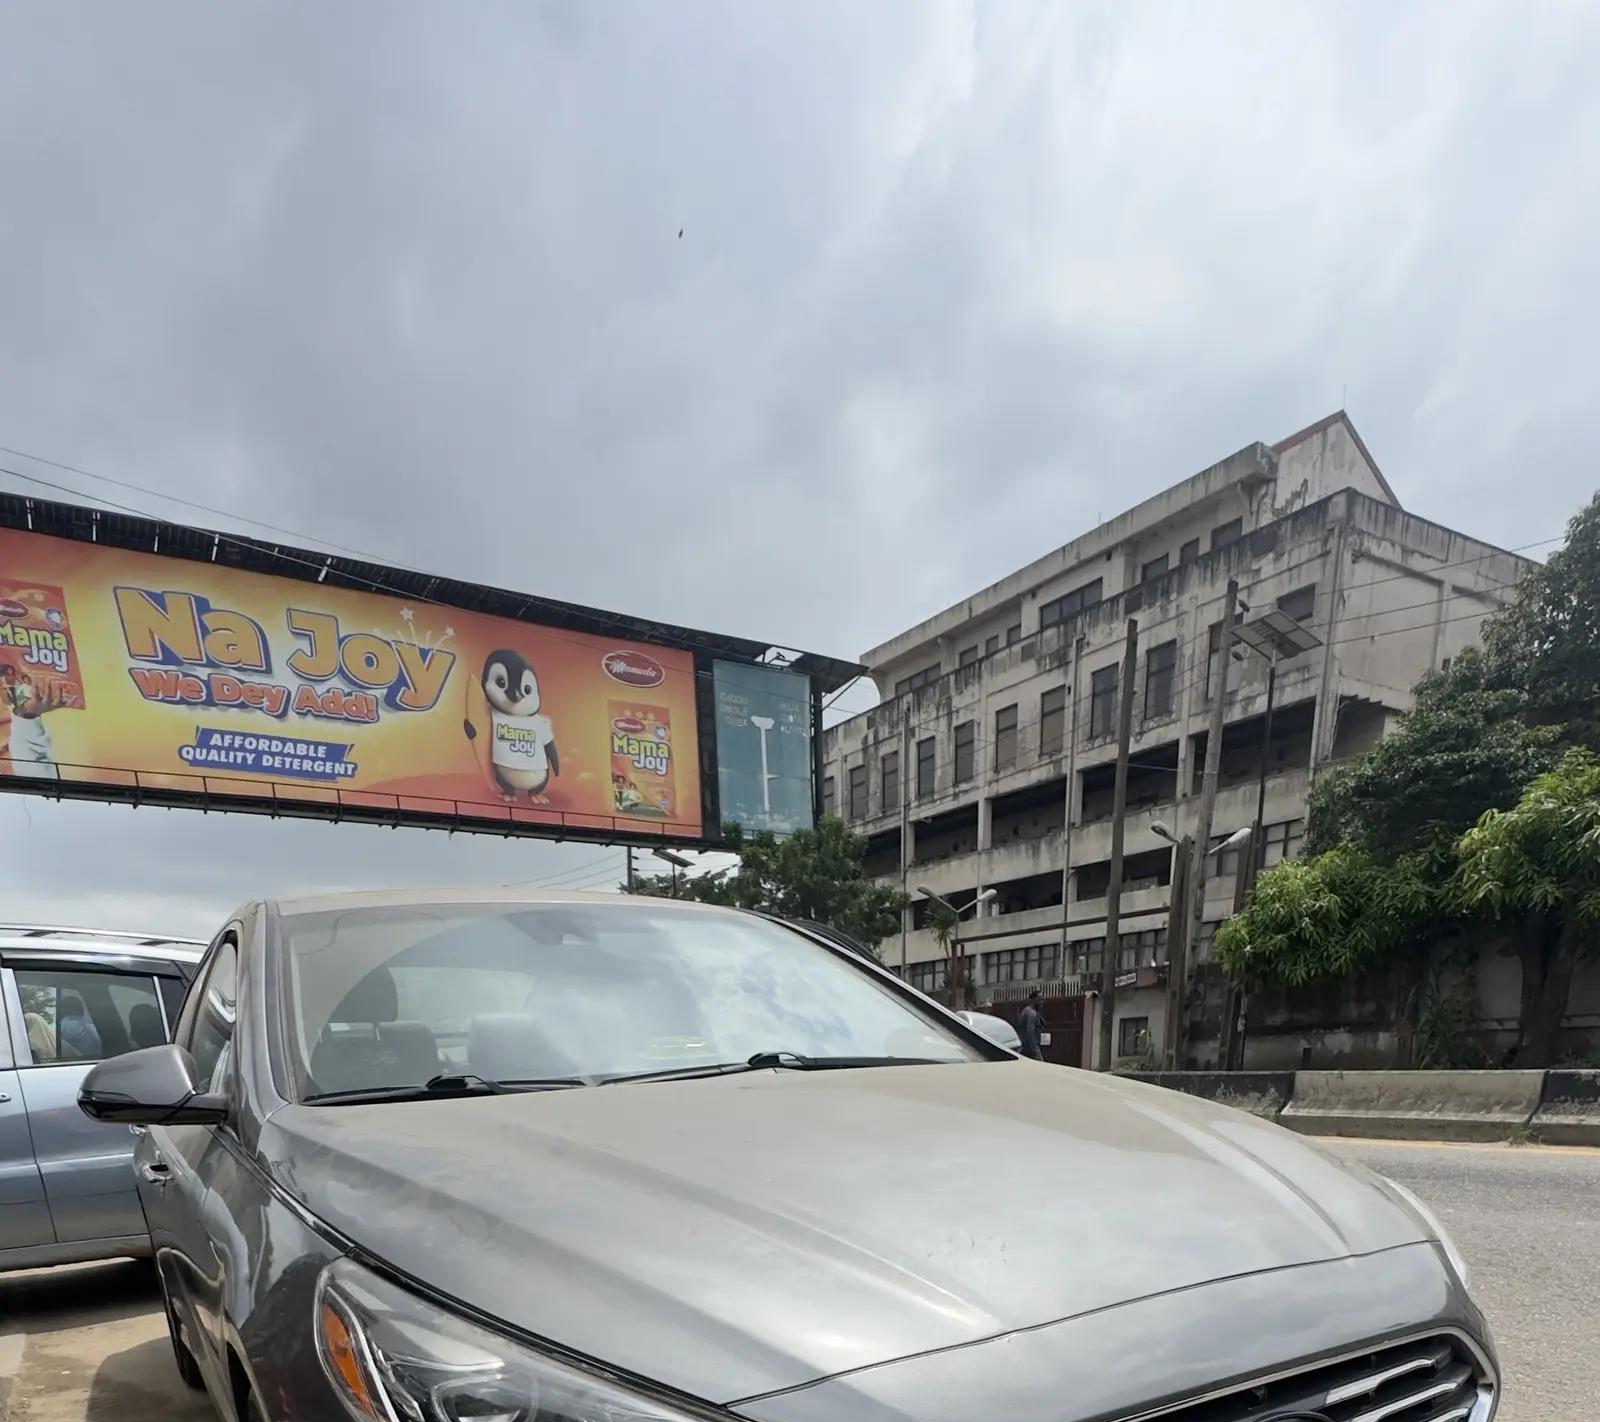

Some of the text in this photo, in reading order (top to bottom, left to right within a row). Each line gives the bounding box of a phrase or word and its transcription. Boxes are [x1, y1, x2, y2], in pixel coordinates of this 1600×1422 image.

[23, 644, 69, 673] Joy
[113, 586, 456, 712] Na Joy
[129, 668, 379, 722] We Dey Add!
[209, 733, 327, 758] AFFORDABLE
[497, 723, 536, 743] Mama
[611, 732, 669, 759] Mama
[181, 746, 355, 775] QUALITY DETERGENT
[509, 740, 536, 757] Joy
[633, 751, 669, 776] Joy
